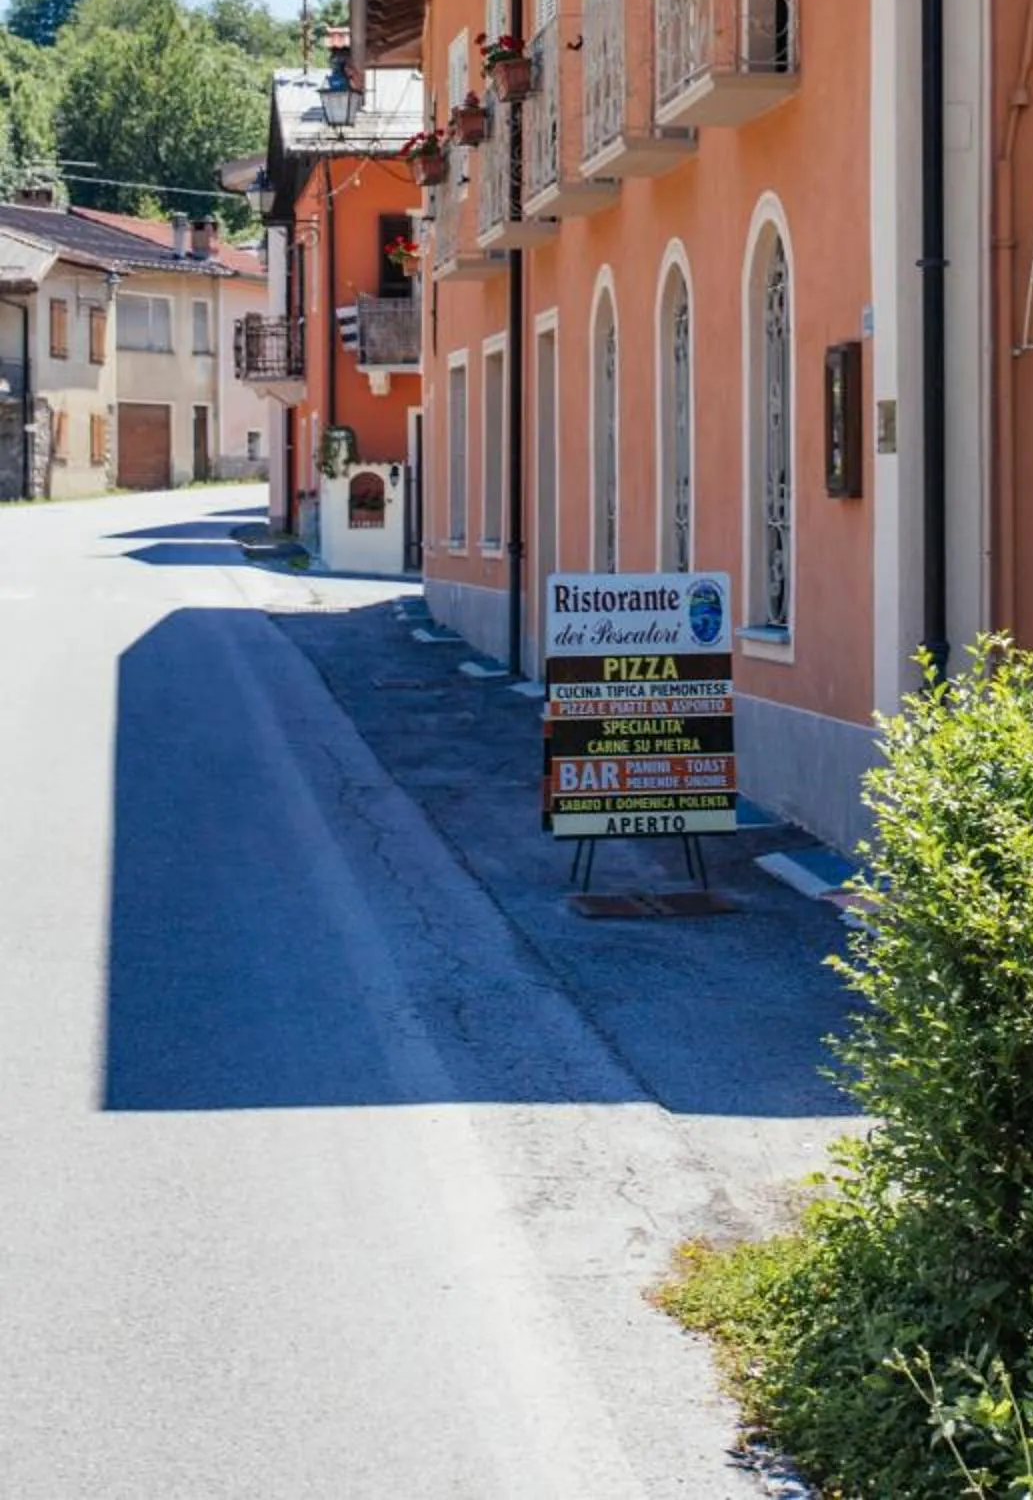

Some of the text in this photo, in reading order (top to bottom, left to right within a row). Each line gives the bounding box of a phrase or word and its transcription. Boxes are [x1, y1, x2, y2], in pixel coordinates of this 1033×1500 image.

[554, 585, 680, 613] Ristorante
[555, 623, 588, 646] dei
[591, 617, 682, 646] Pescatori
[603, 657, 679, 681] PIZZA
[556, 683, 728, 699] CUCINA TIPICA PIEMONTESE
[559, 699, 725, 716] PIZZA E PIATTI DA ASPORTO
[587, 738, 701, 754] CARNE SU PIETRA
[626, 761, 671, 774] PANINI
[687, 759, 728, 773] TOAST
[560, 762, 621, 791] BAR
[559, 798, 600, 812] SABATO
[616, 797, 675, 810] DOMENICA
[679, 795, 729, 808] POLENTA
[606, 815, 685, 835] APERTO
